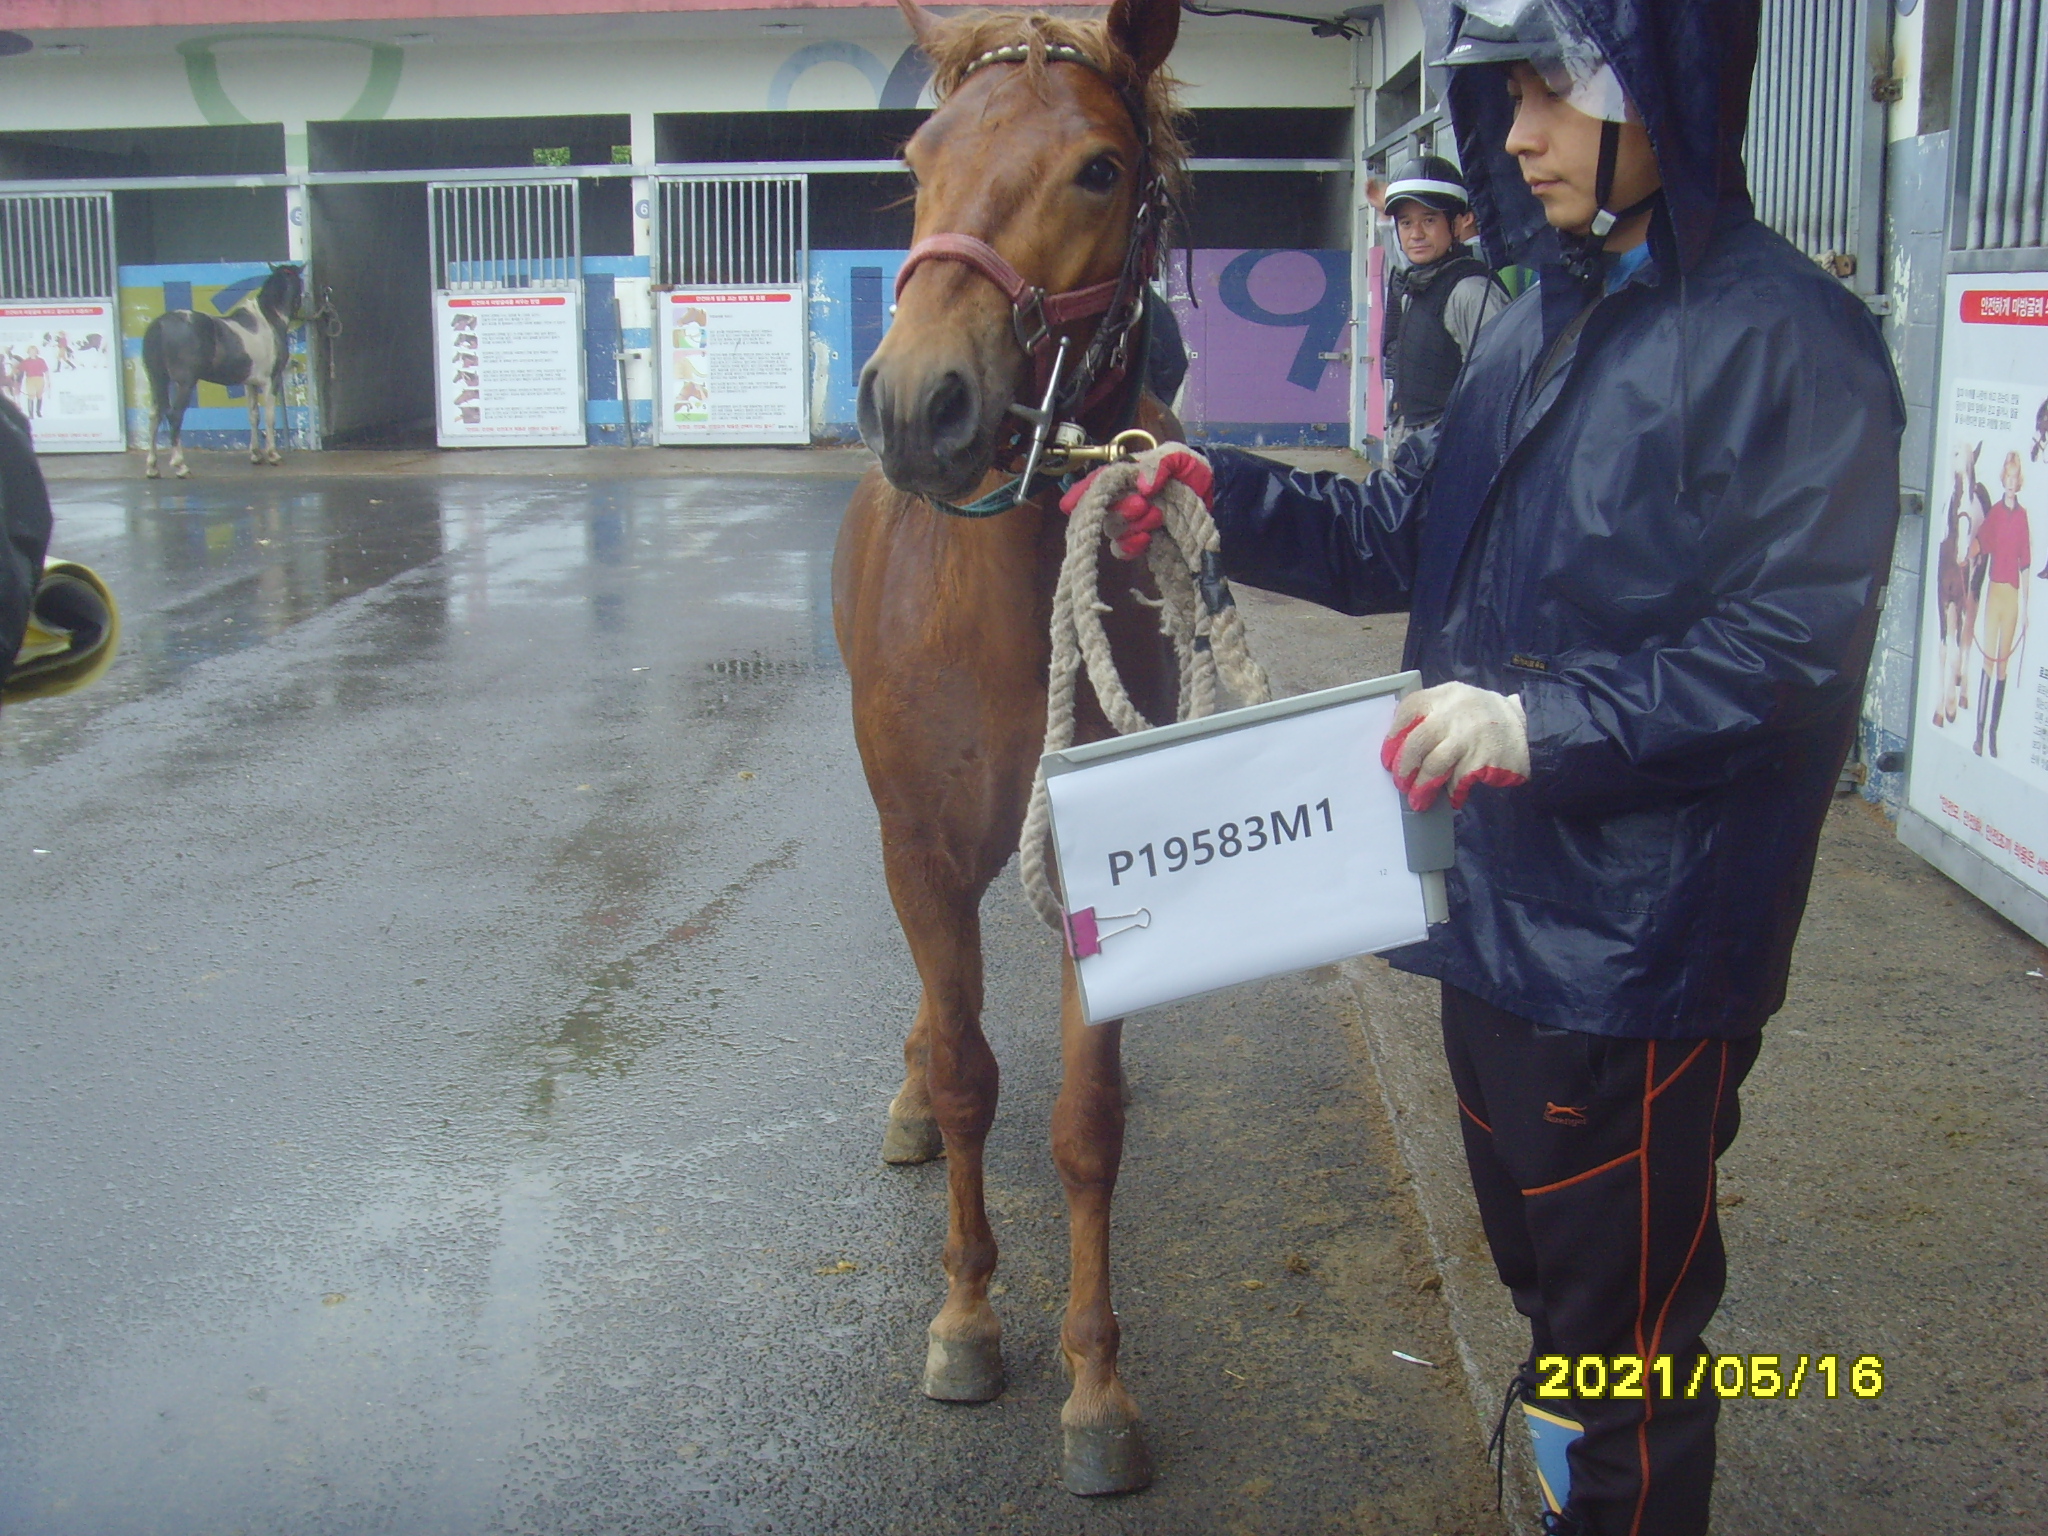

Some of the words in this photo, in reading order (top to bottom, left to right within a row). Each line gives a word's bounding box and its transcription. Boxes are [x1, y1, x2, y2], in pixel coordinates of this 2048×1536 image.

[640, 203, 649, 215] 6
[1981, 297, 2010, 317] 안전하게
[2011, 297, 2043, 317] 마방굴레
[1108, 797, 1334, 887] P19583M1
